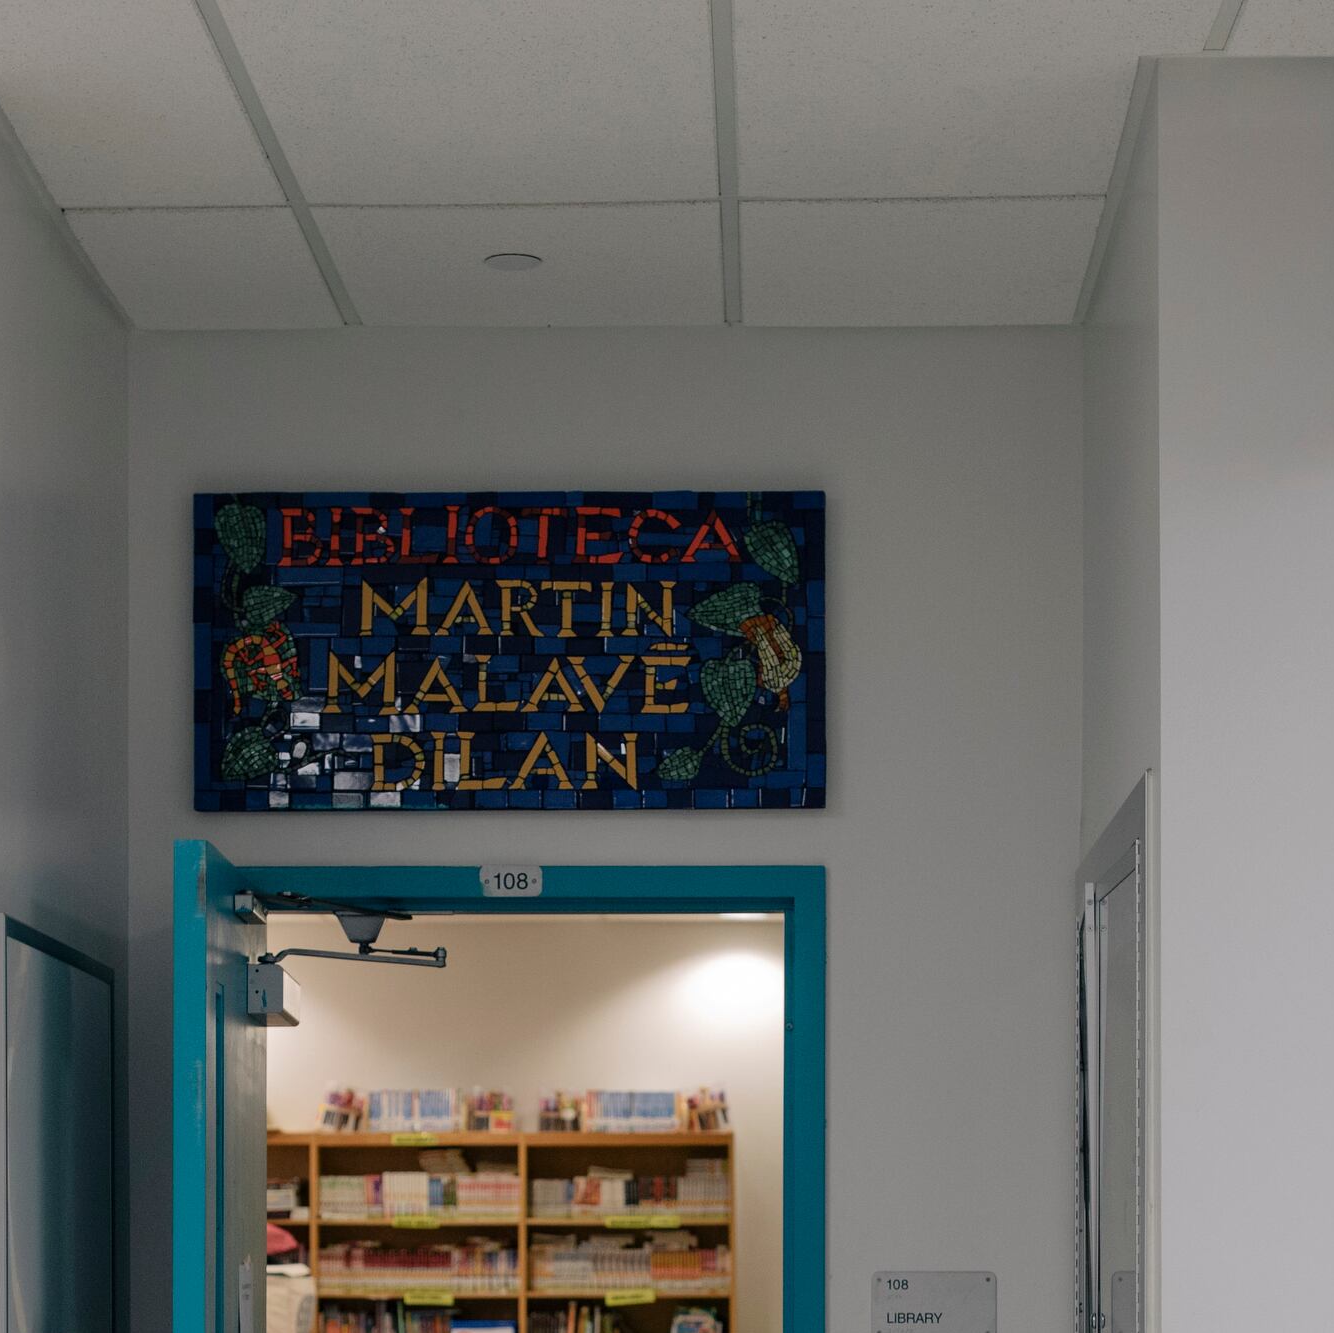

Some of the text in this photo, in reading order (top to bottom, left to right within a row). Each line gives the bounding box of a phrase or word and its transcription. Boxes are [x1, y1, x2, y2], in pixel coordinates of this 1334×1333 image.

[277, 506, 743, 567] BIBLIOTECA
[360, 579, 676, 637] MARTIN
[372, 731, 639, 791] DILAN
[494, 873, 528, 889] 108
[887, 1279, 908, 1290] 108
[887, 1313, 942, 1323] LIBRARY
